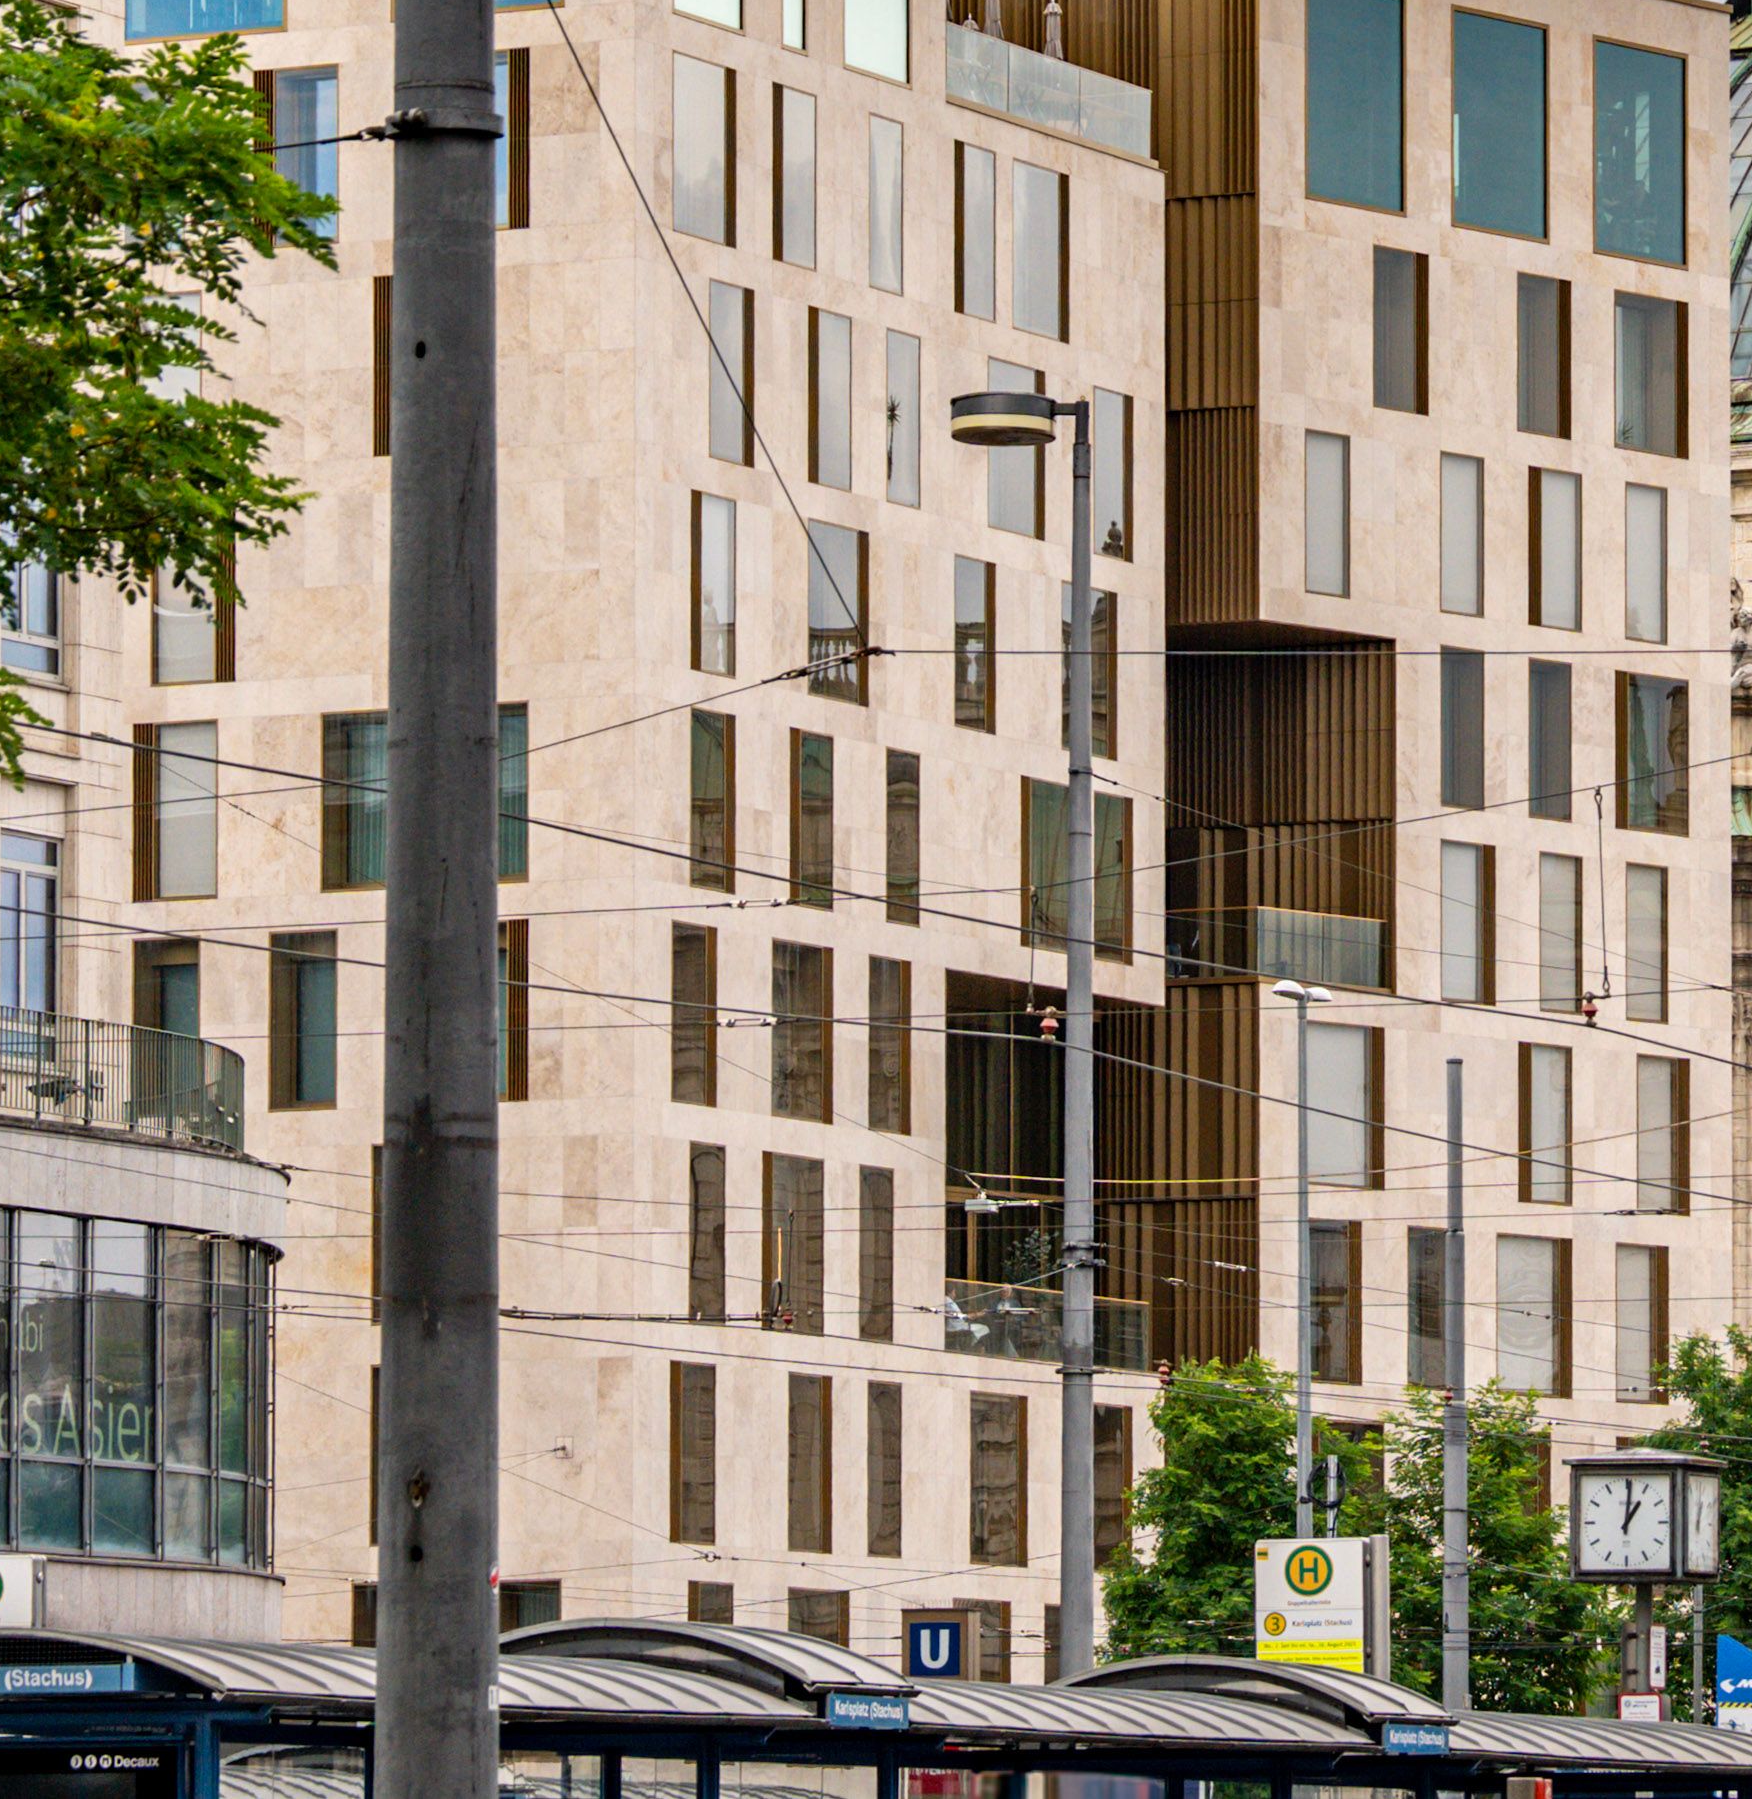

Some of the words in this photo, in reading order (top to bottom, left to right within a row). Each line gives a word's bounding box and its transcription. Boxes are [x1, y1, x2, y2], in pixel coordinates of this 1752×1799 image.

[1298, 1556, 1319, 1584] H
[1270, 1616, 1281, 1632] 3
[919, 1628, 950, 1669] U
[4, 1669, 93, 1691] (Stachus)
[835, 1699, 869, 1720] Karlsplatz
[869, 1701, 904, 1722] (Stachus)
[113, 1755, 160, 1769] Decaux
